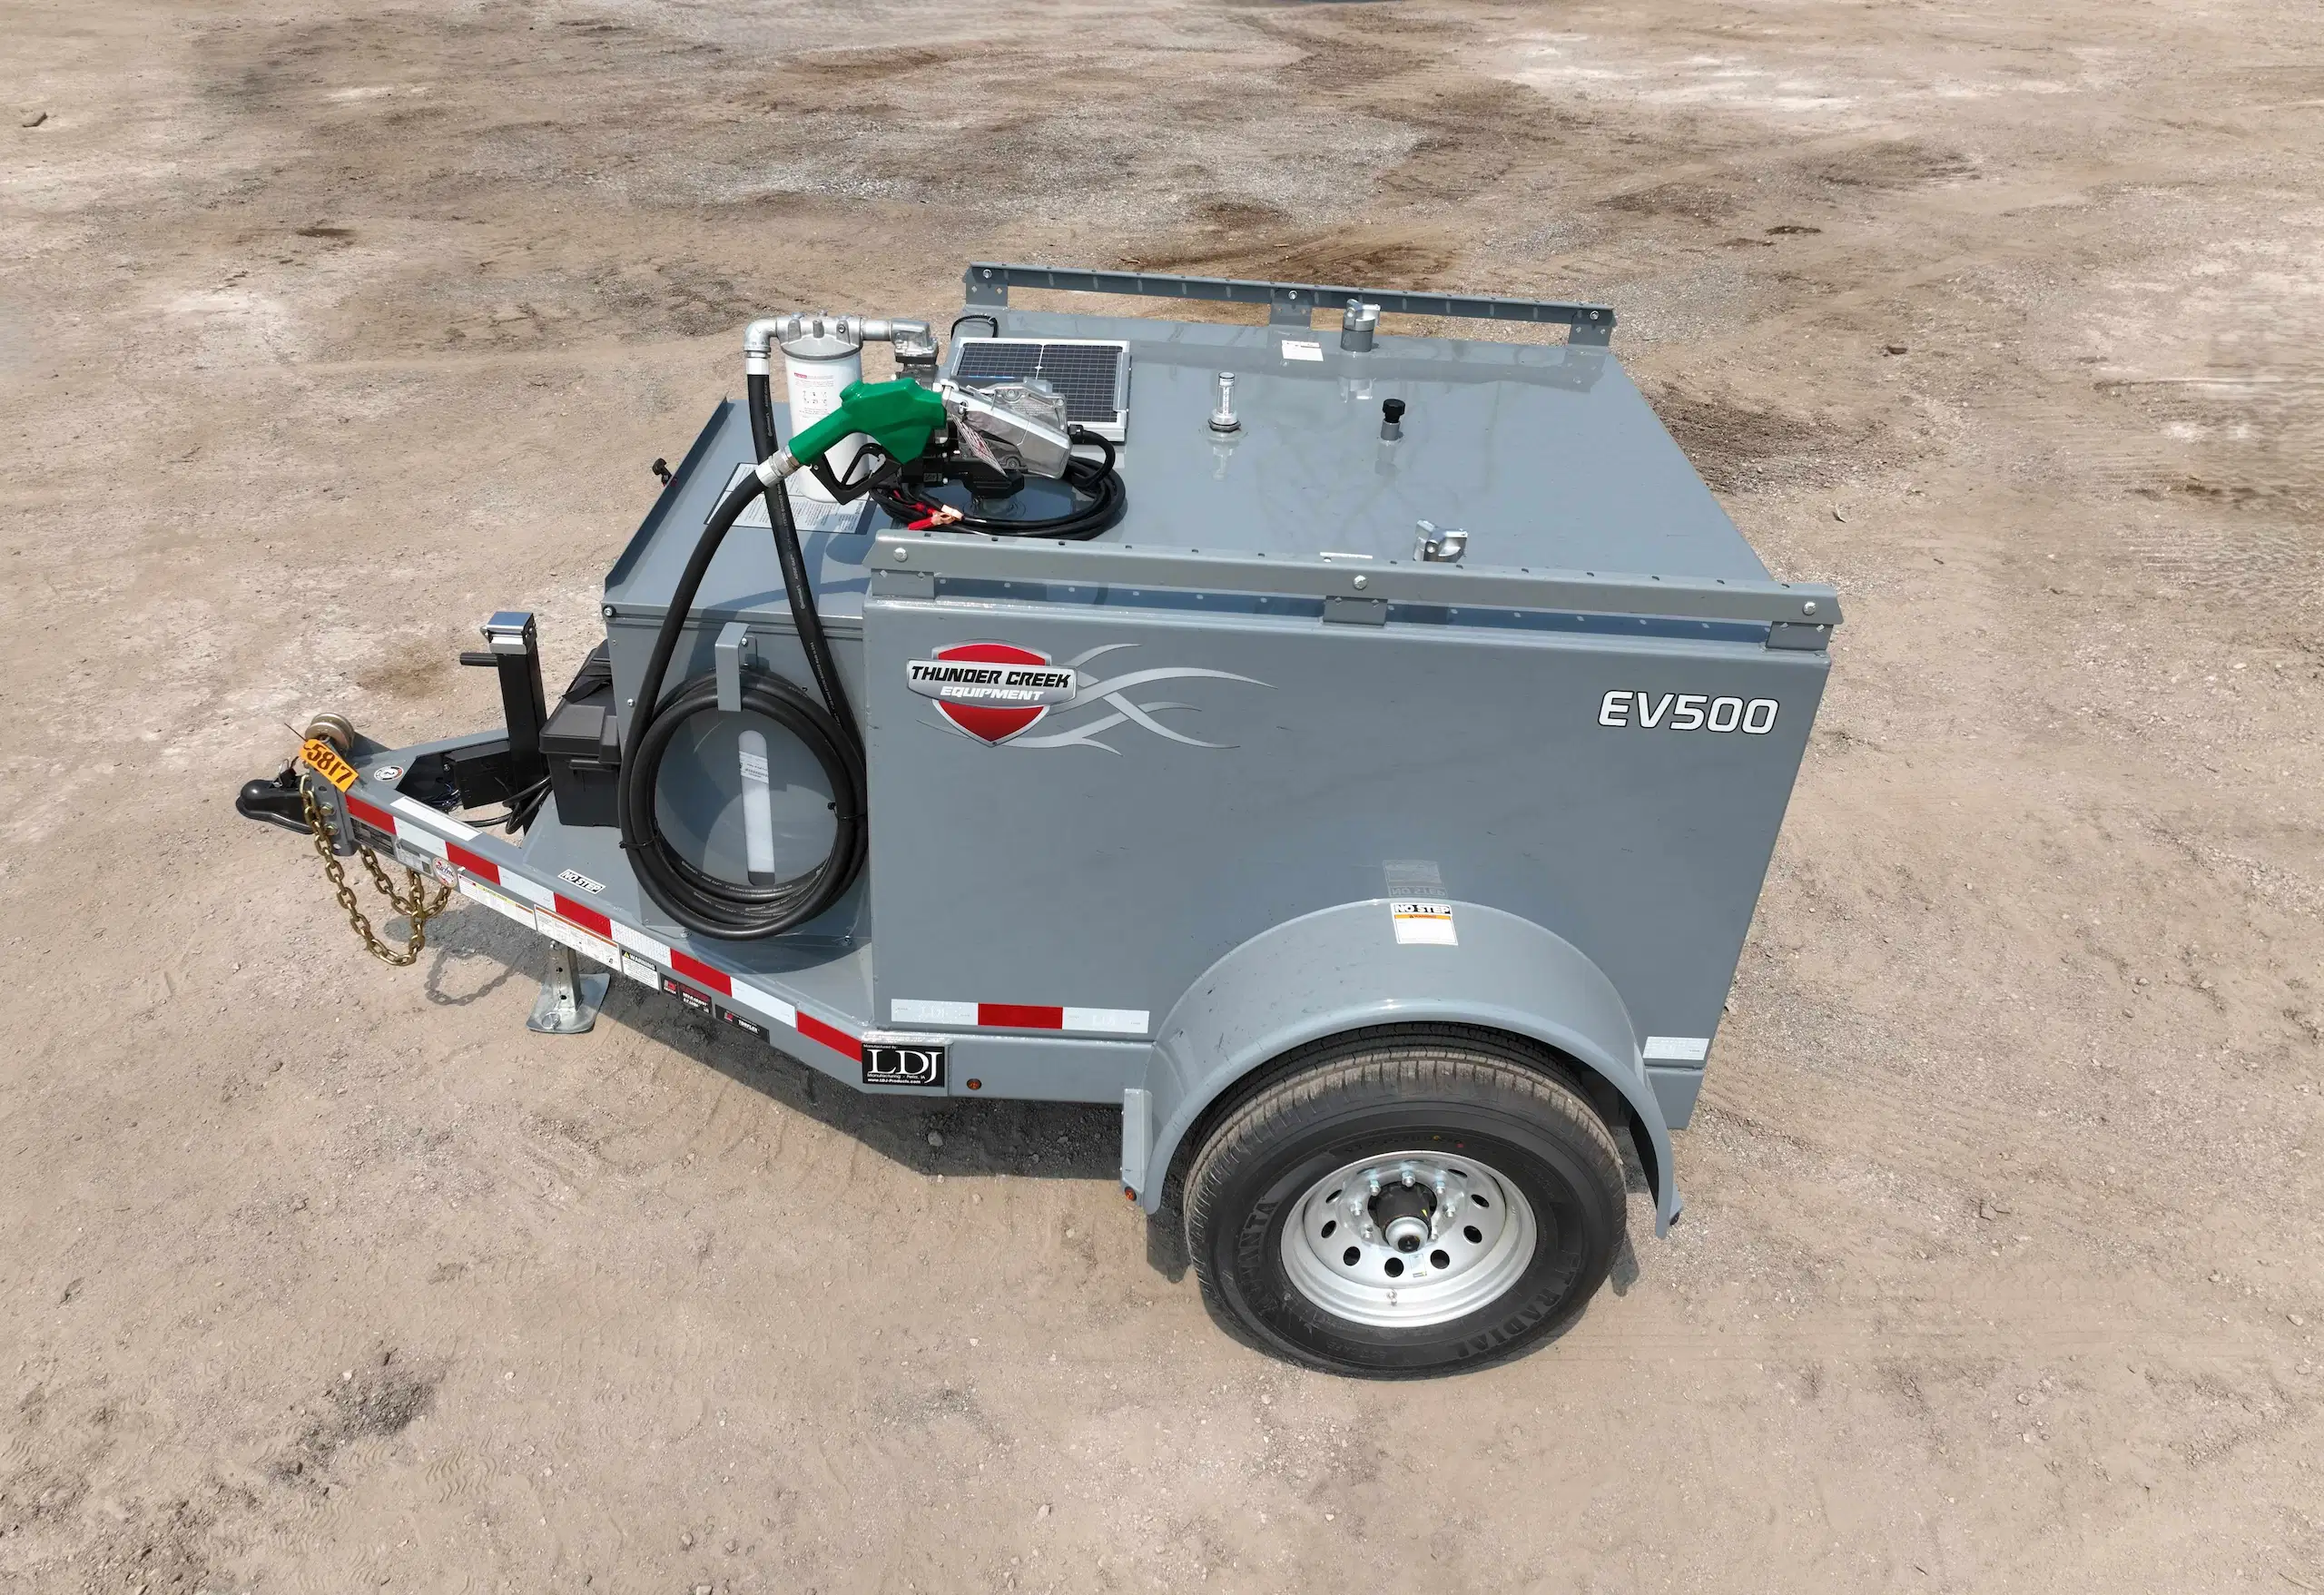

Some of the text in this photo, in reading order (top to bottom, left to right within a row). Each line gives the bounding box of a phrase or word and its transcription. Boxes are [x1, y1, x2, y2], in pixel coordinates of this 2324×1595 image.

[911, 665, 1072, 689] THUNDER CREEK
[940, 686, 1045, 702] EQUIPMENT
[1598, 689, 1780, 735] EV500
[306, 743, 353, 784] 5817
[561, 871, 603, 892] NO STEP
[1394, 904, 1451, 914] NO STEP
[867, 1049, 943, 1084] LDJ
[1457, 1285, 1562, 1359] RADIAL
